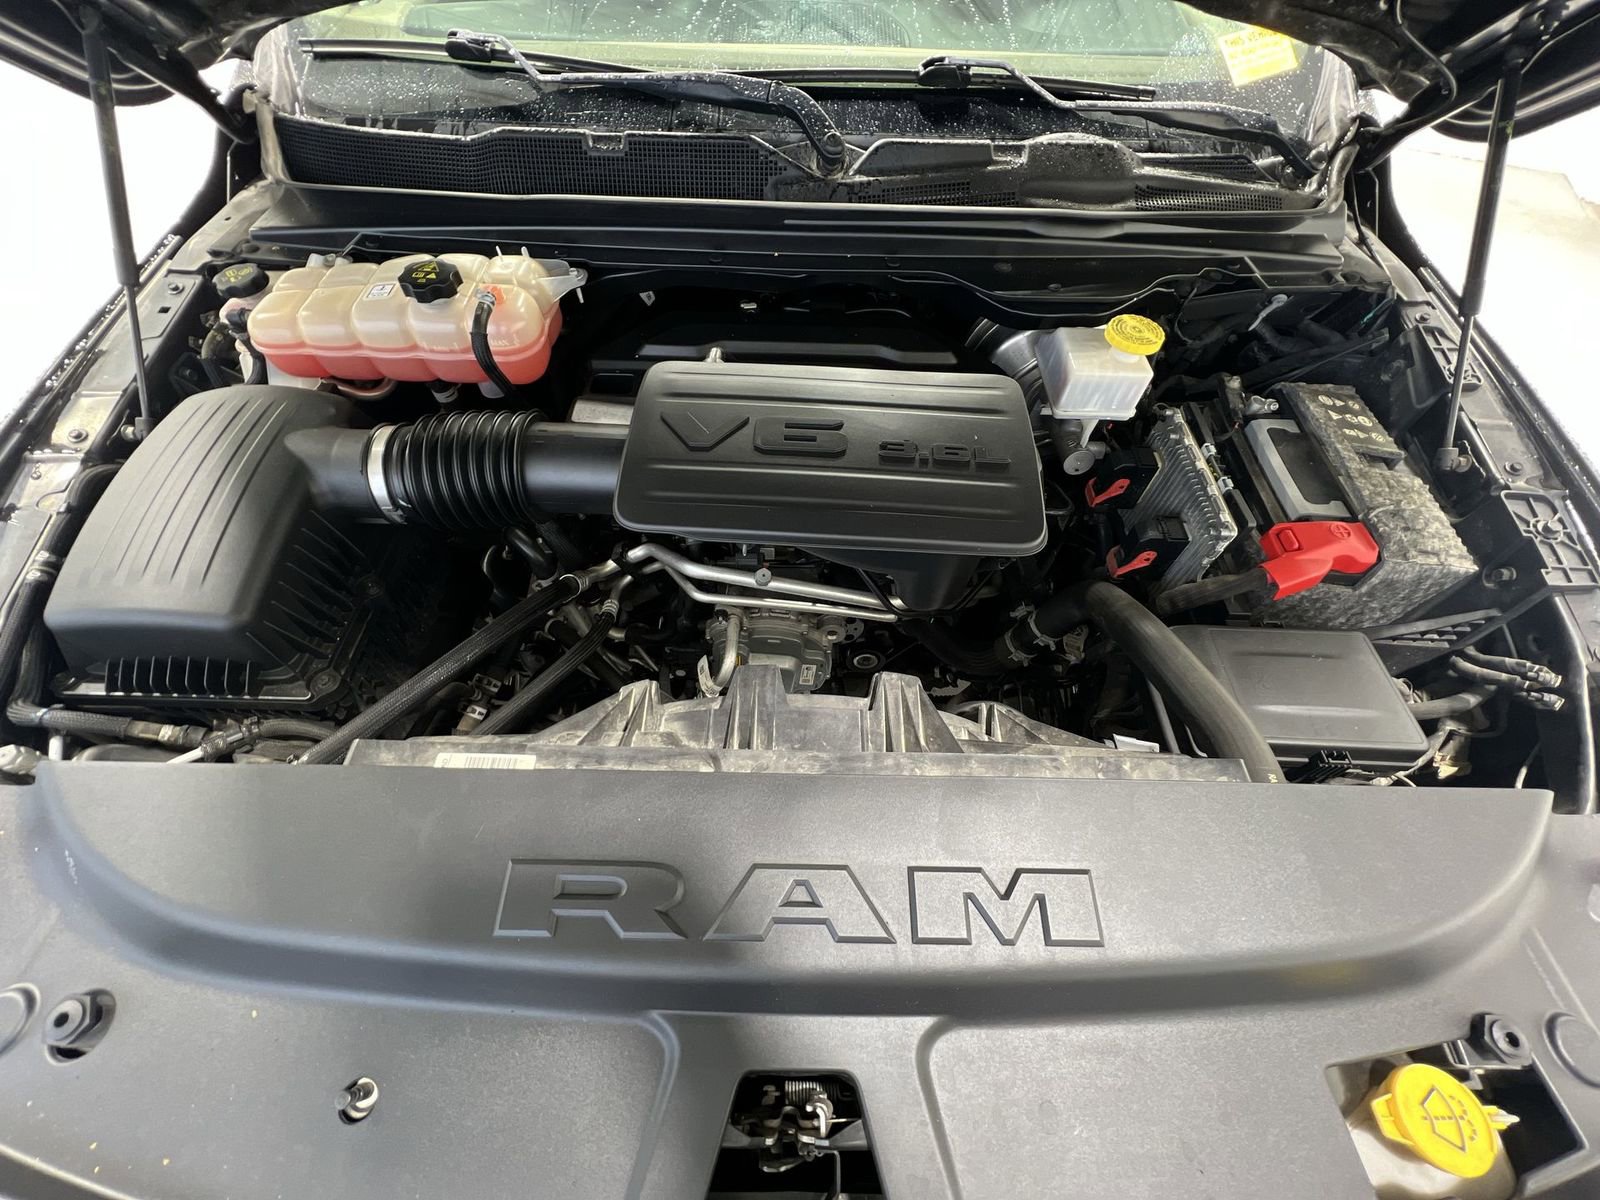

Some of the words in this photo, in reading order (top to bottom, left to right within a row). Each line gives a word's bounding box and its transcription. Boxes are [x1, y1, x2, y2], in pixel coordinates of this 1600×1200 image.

[660, 411, 849, 457] V6
[879, 438, 1011, 465] 3.6L
[492, 859, 1105, 948] RAM
